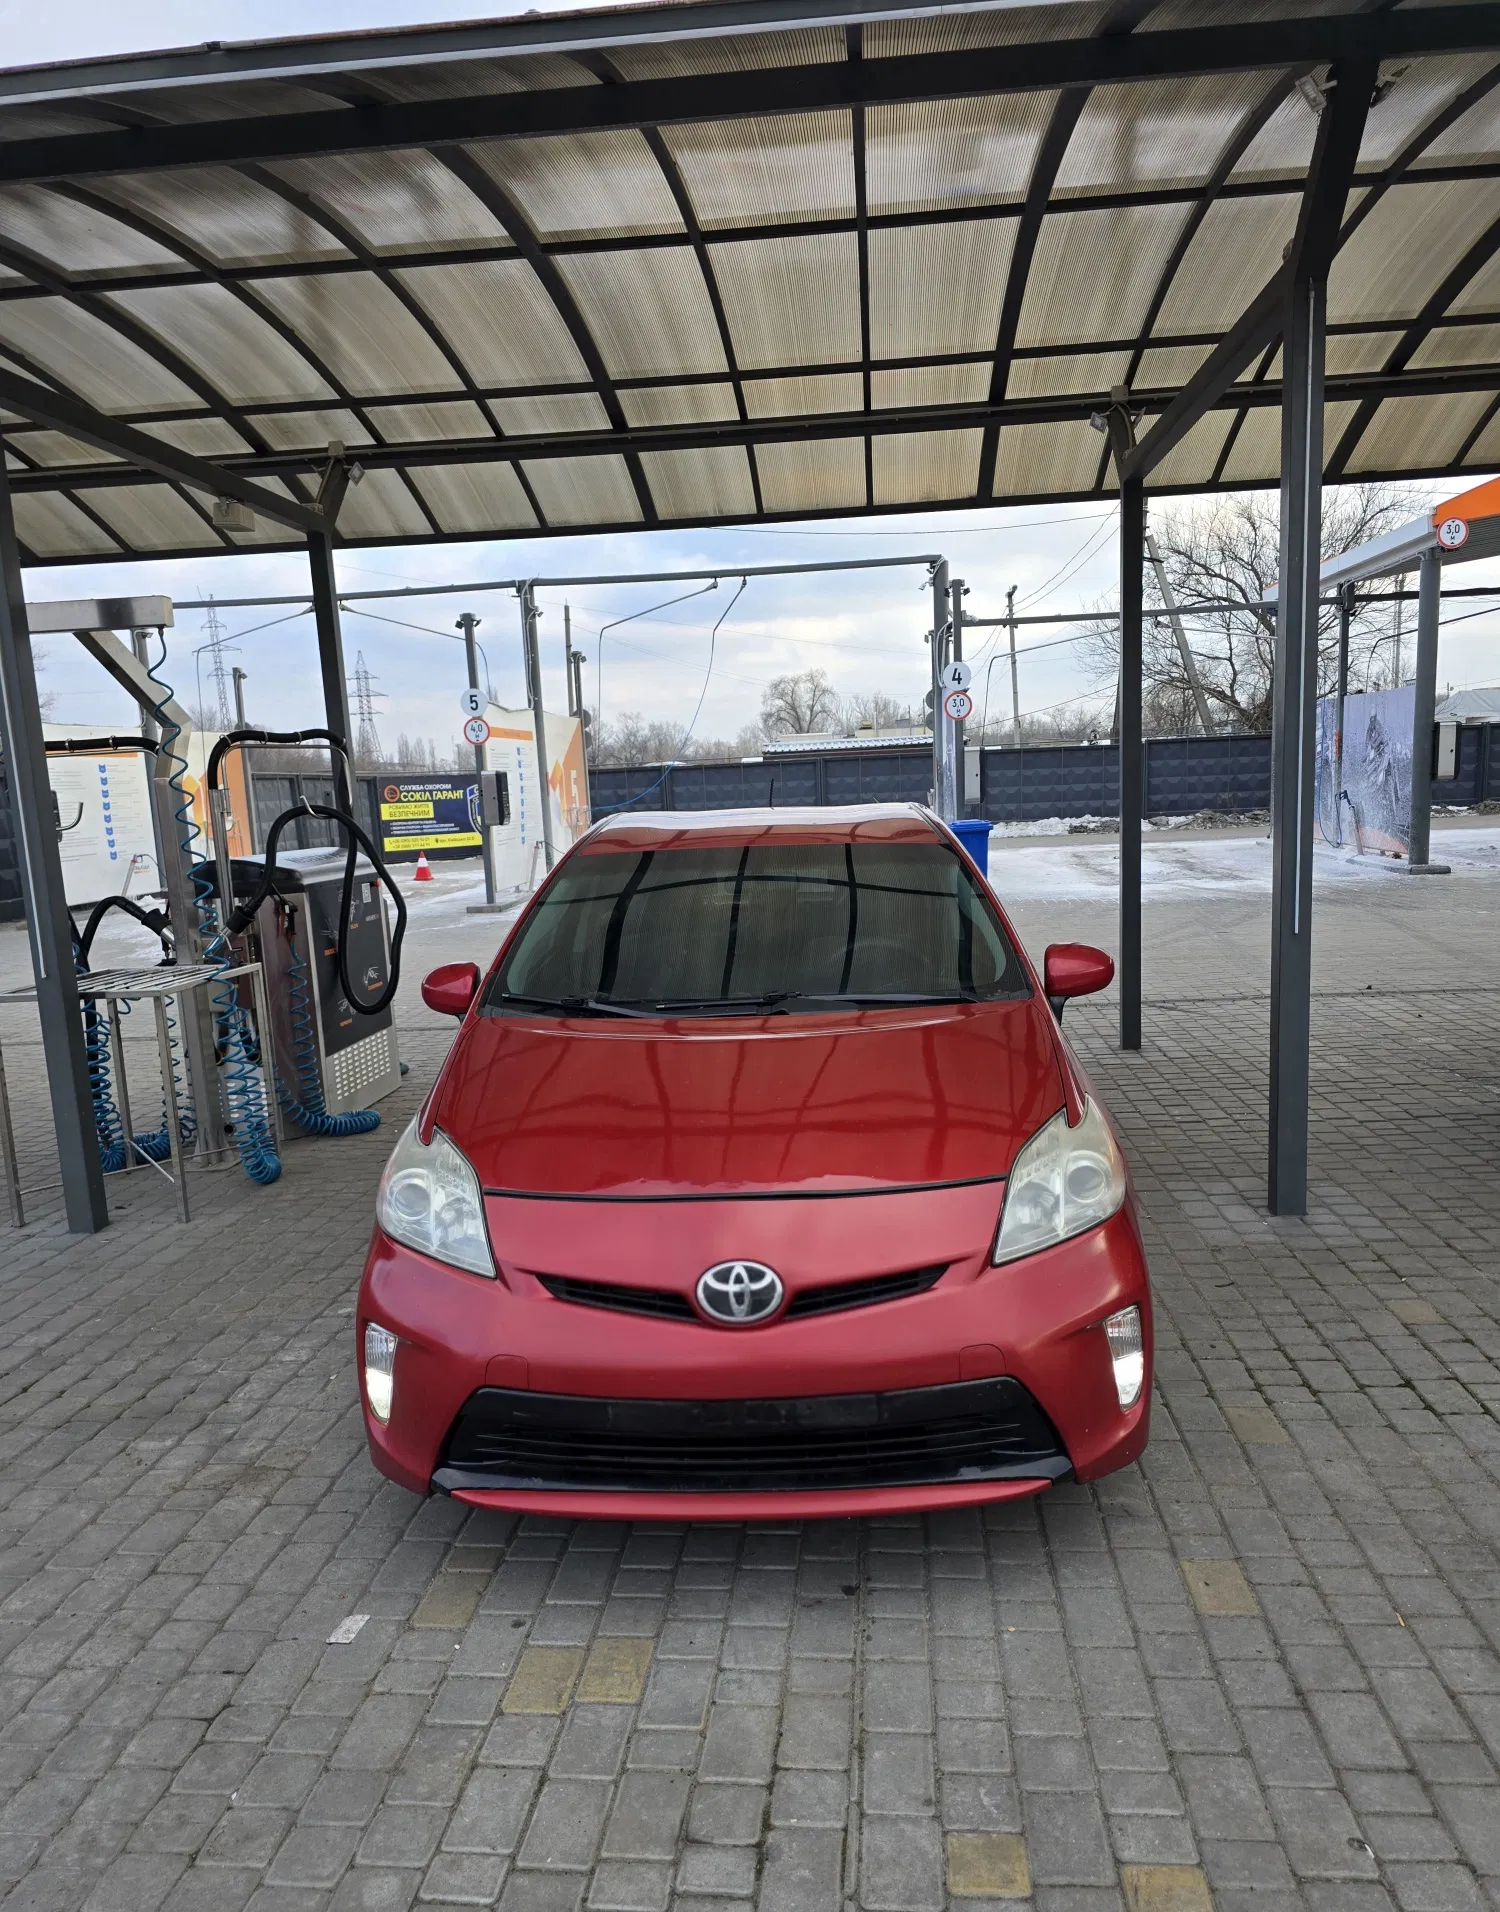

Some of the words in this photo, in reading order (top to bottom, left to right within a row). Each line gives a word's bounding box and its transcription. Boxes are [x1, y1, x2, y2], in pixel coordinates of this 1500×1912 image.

[952, 668, 962, 684] 4
[469, 694, 478, 711] 5
[401, 792, 431, 801] СОКІЛ
[433, 790, 464, 800] ГАРАНТ
